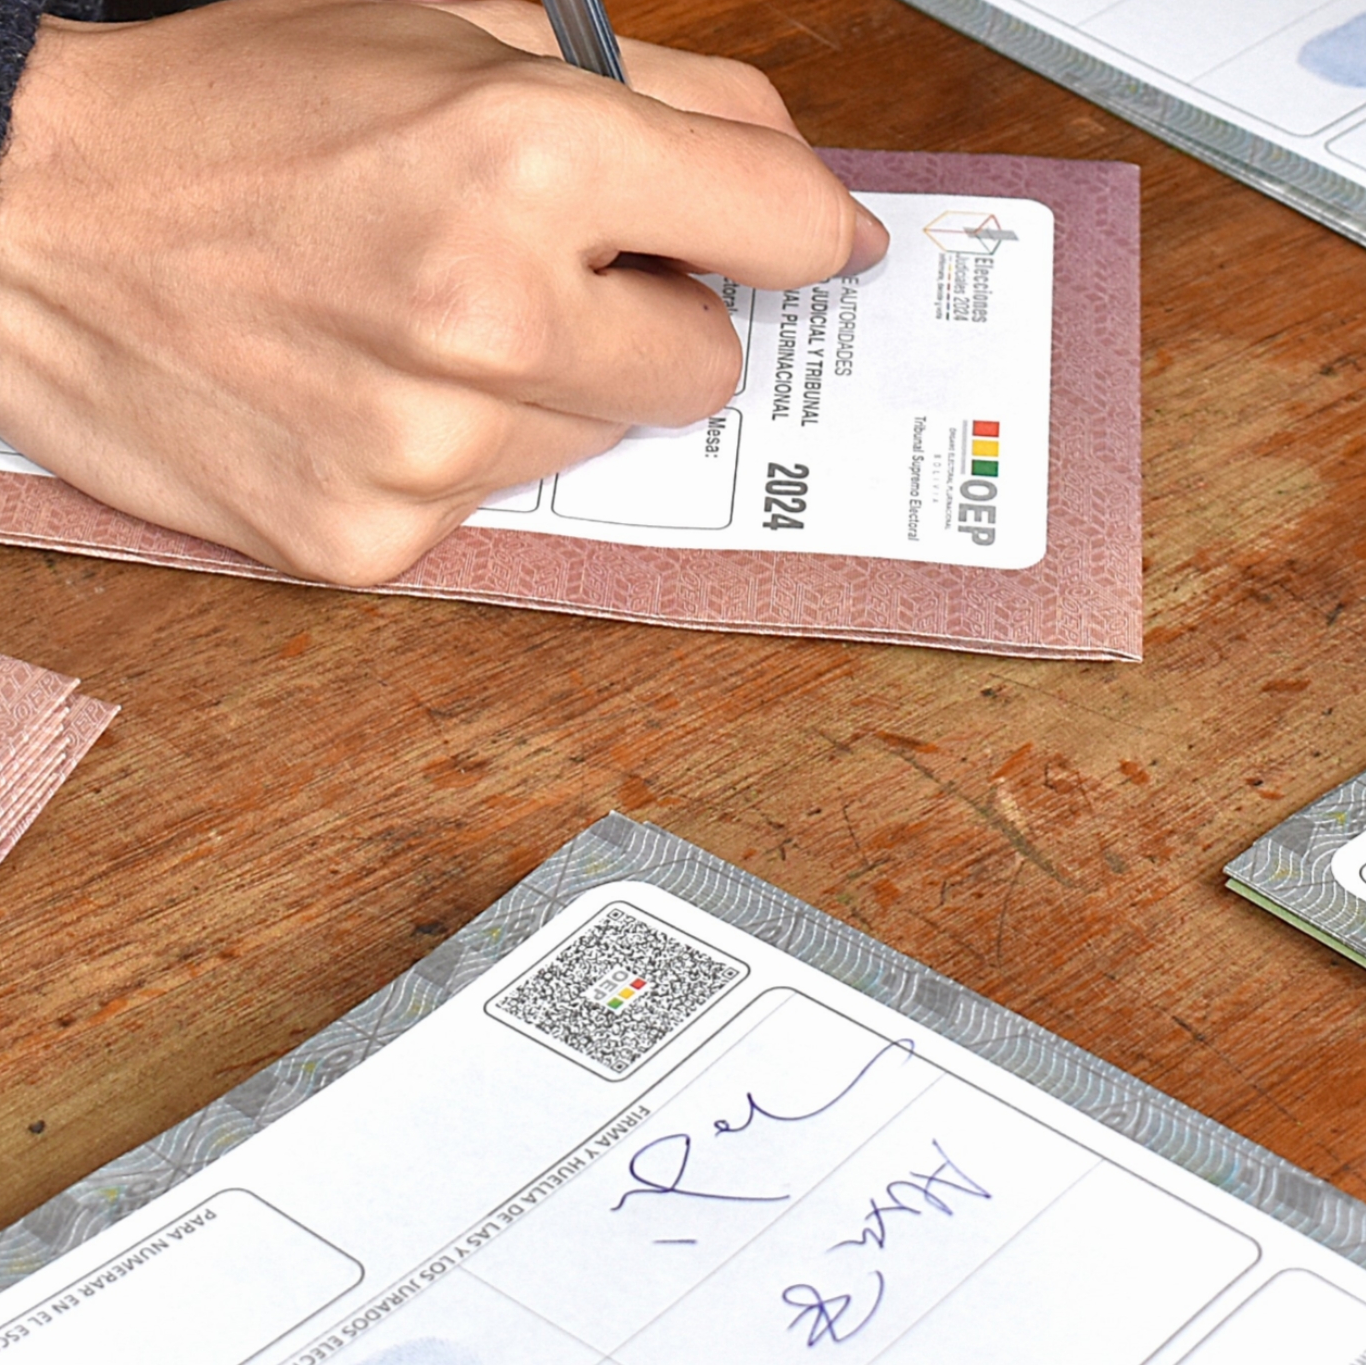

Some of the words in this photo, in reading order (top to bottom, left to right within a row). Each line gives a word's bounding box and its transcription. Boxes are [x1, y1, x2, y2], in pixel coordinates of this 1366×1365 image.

[953, 297, 970, 321] 2024
[971, 257, 994, 323] Elecciones
[808, 286, 829, 345] JUDICIAL
[834, 286, 858, 376] AUTORIDADES
[771, 313, 799, 421] PLURINACIONAL
[807, 348, 824, 358] Y
[801, 360, 823, 427] TRIBUNAL
[705, 415, 727, 458] Mesa:
[912, 416, 927, 453] Tribunal
[762, 462, 810, 531] 2024
[909, 455, 925, 497] Supremo
[907, 499, 922, 541] Electoral
[957, 479, 998, 546] OEP
[591, 968, 629, 1001] OEP
[587, 1105, 651, 1147] FIRMA
[584, 1148, 600, 1160] Y
[513, 1157, 586, 1204] HUELLA
[166, 1208, 217, 1240] PARA
[466, 1222, 501, 1247] LAS
[497, 1204, 525, 1224] DE
[78, 1238, 170, 1297] NUMERAR
[419, 1255, 456, 1282] LOS
[454, 1247, 470, 1258] Y
[27, 1311, 53, 1326] EL
[51, 1294, 80, 1314] EN
[341, 1279, 421, 1338] JURADOS
